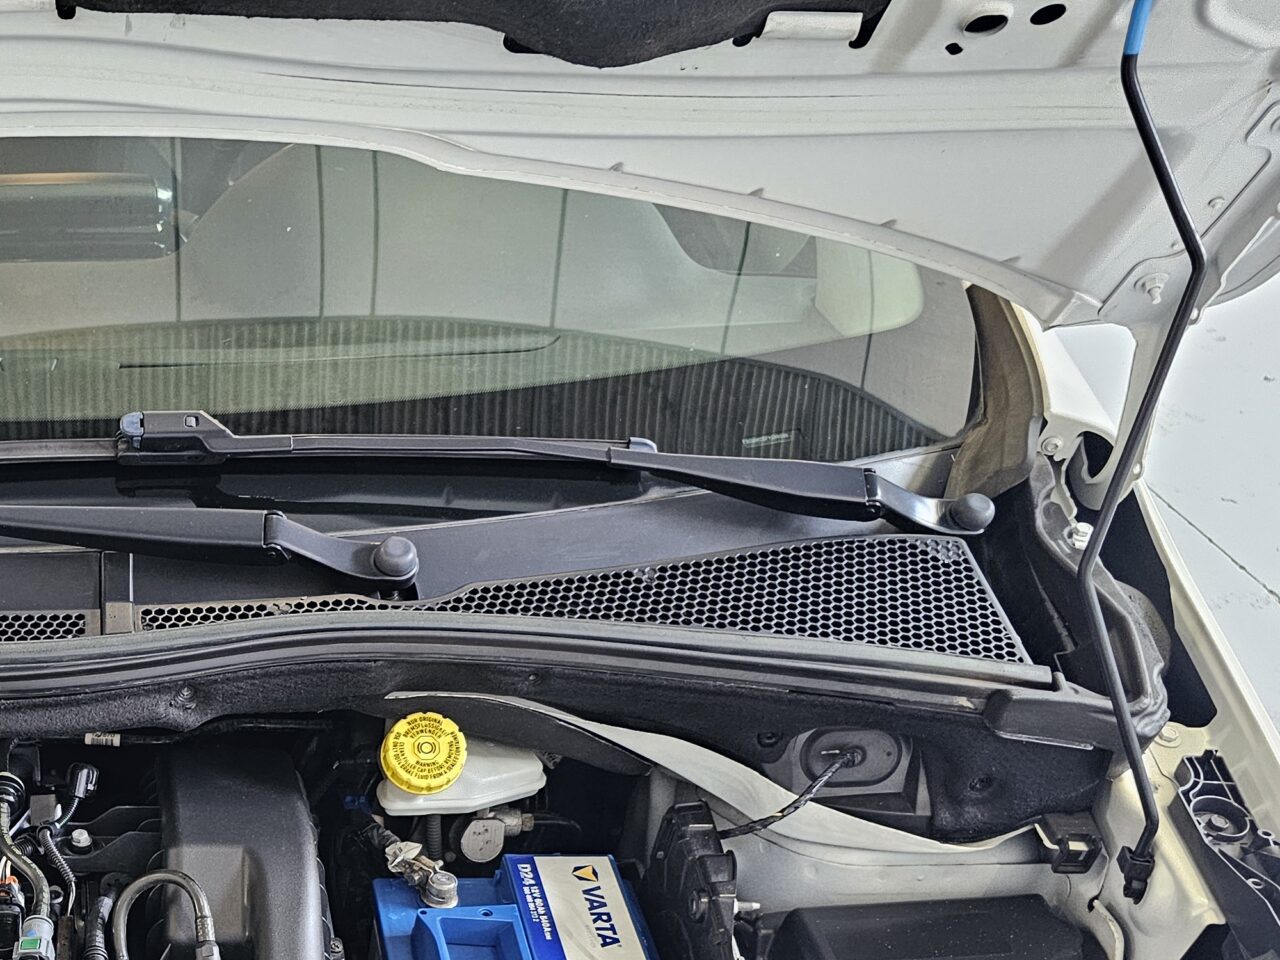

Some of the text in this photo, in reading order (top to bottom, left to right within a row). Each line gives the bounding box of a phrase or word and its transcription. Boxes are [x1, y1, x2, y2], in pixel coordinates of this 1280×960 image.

[419, 716, 443, 726] ORIGINAL
[415, 760, 439, 768] WARNING
[517, 863, 536, 885] D24
[582, 885, 621, 948] VARTA
